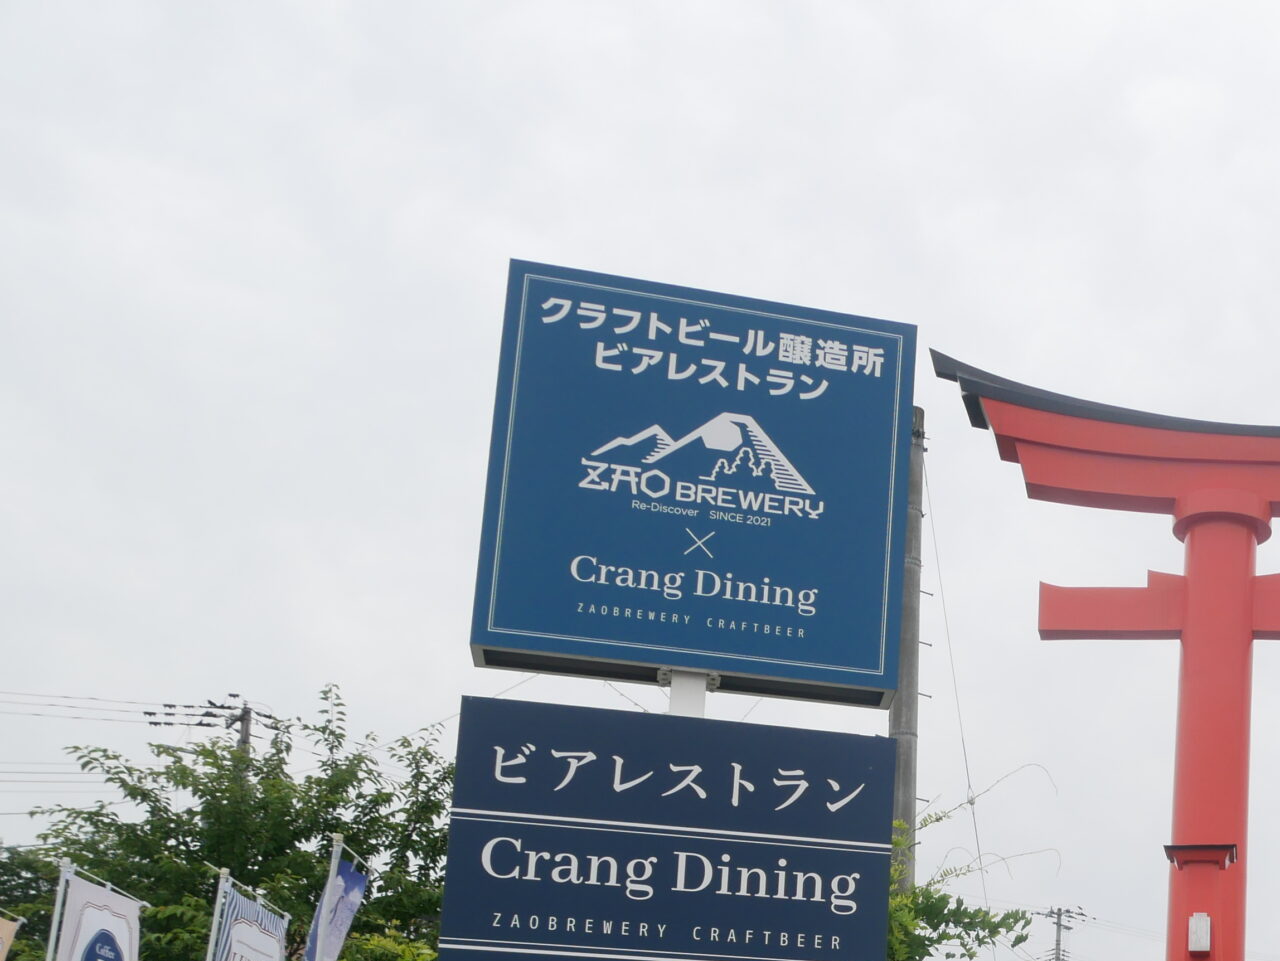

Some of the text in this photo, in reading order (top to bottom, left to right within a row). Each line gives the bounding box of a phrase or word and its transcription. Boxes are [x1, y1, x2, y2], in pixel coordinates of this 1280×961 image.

[540, 296, 885, 378] クラフトビール醸造所
[595, 341, 829, 400] ビアレストラン
[578, 457, 824, 520] ZAO BREWERY
[631, 500, 771, 527] Re-Discover SINCE 2021
[569, 554, 818, 616] Crang Dining
[577, 602, 806, 638] ZAOBREWERY CRAFTBEER
[493, 743, 865, 813] ビアレストラン
[481, 837, 860, 915] Crang Dining
[492, 913, 841, 951] ZAOBREWERY CRAFTBEER
